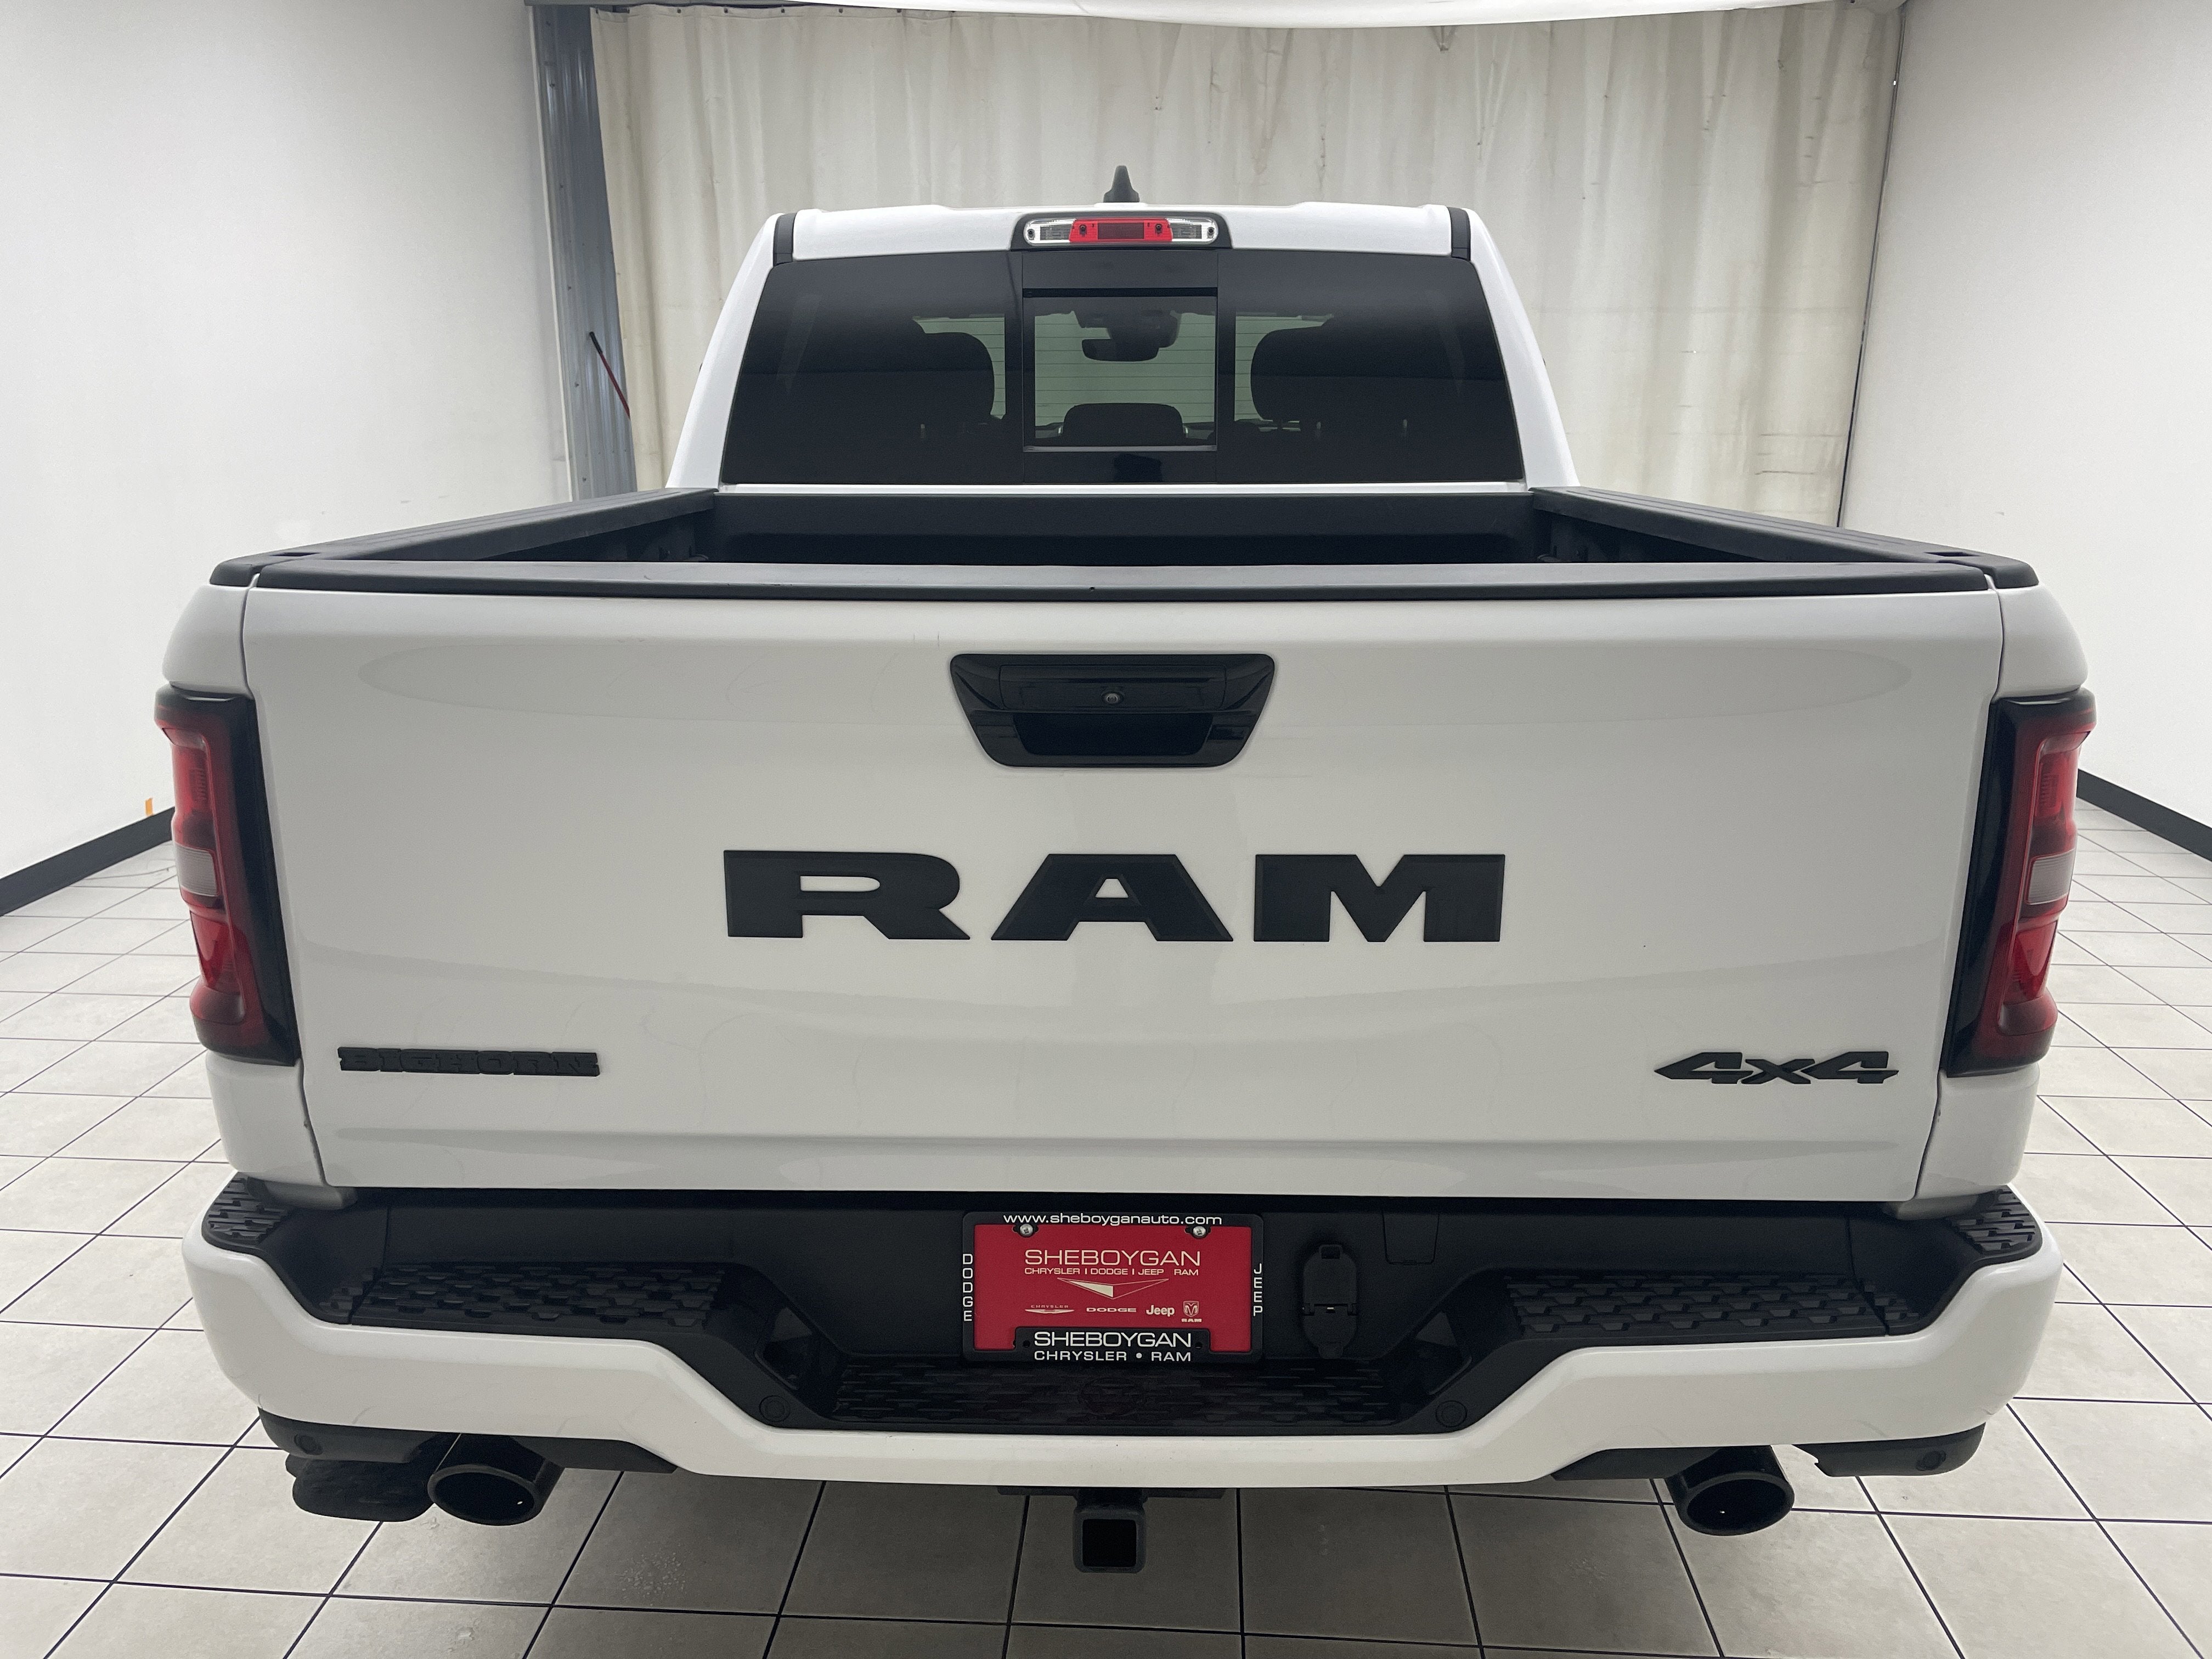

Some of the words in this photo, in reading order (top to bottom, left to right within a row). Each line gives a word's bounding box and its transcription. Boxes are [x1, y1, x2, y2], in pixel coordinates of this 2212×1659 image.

[723, 850, 1508, 943] RAM
[337, 1046, 601, 1077] BIGHORN
[1654, 1051, 1900, 1085] 4x4
[1003, 1212, 1222, 1226] www.sheboyganauto.com
[1025, 1249, 1200, 1266] SHEBOYGAN
[962, 1254, 974, 1322] DODGE
[1253, 1263, 1263, 1317] JEEP
[1146, 1305, 1175, 1317] Jeep
[1034, 1331, 1191, 1347] SHEBOYGAN
[1034, 1351, 1127, 1361] CHRYSLER
[1151, 1351, 1191, 1362] RAM
